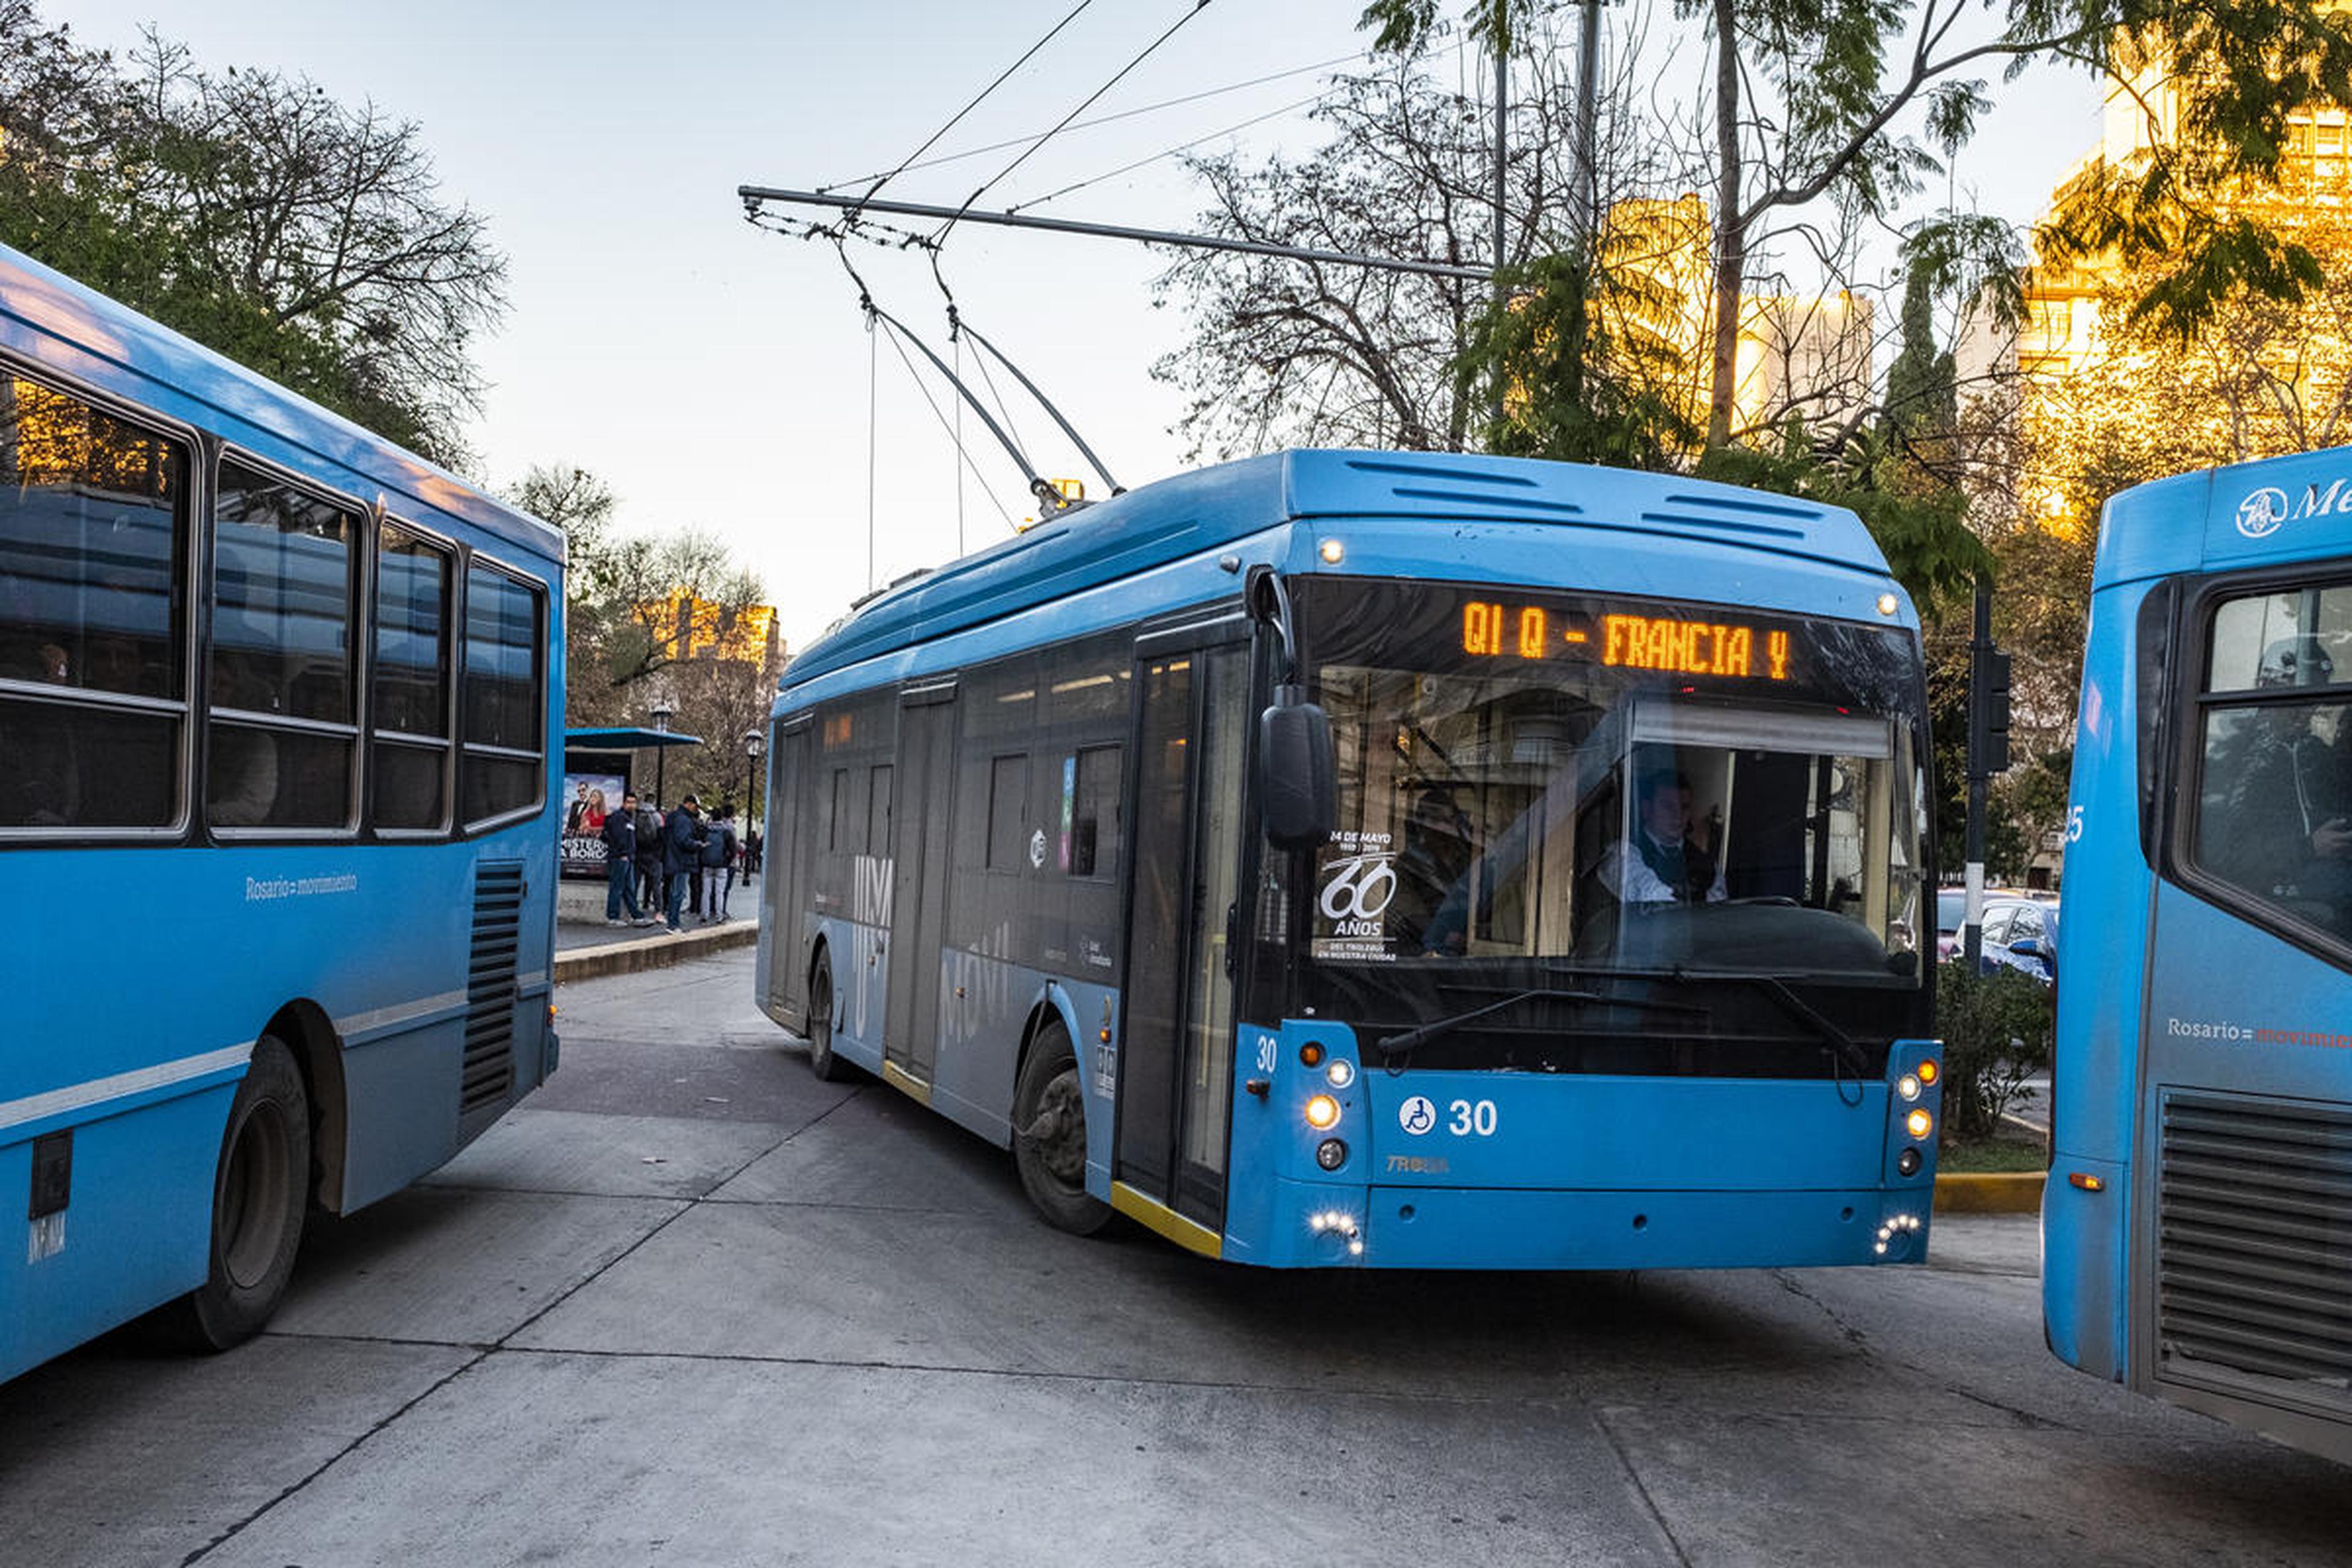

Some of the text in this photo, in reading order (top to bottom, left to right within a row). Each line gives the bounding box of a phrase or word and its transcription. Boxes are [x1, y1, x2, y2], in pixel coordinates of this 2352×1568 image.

[1603, 614, 1751, 676] FRANCIA
[1770, 631, 1788, 679] Y
[1344, 831, 1358, 842] DE
[1360, 832, 1392, 844] MAYO
[1321, 851, 1396, 919] 60
[1334, 918, 1381, 936] AÑOS
[1257, 1035, 1277, 1073] 30
[1449, 1099, 1498, 1136] 30
